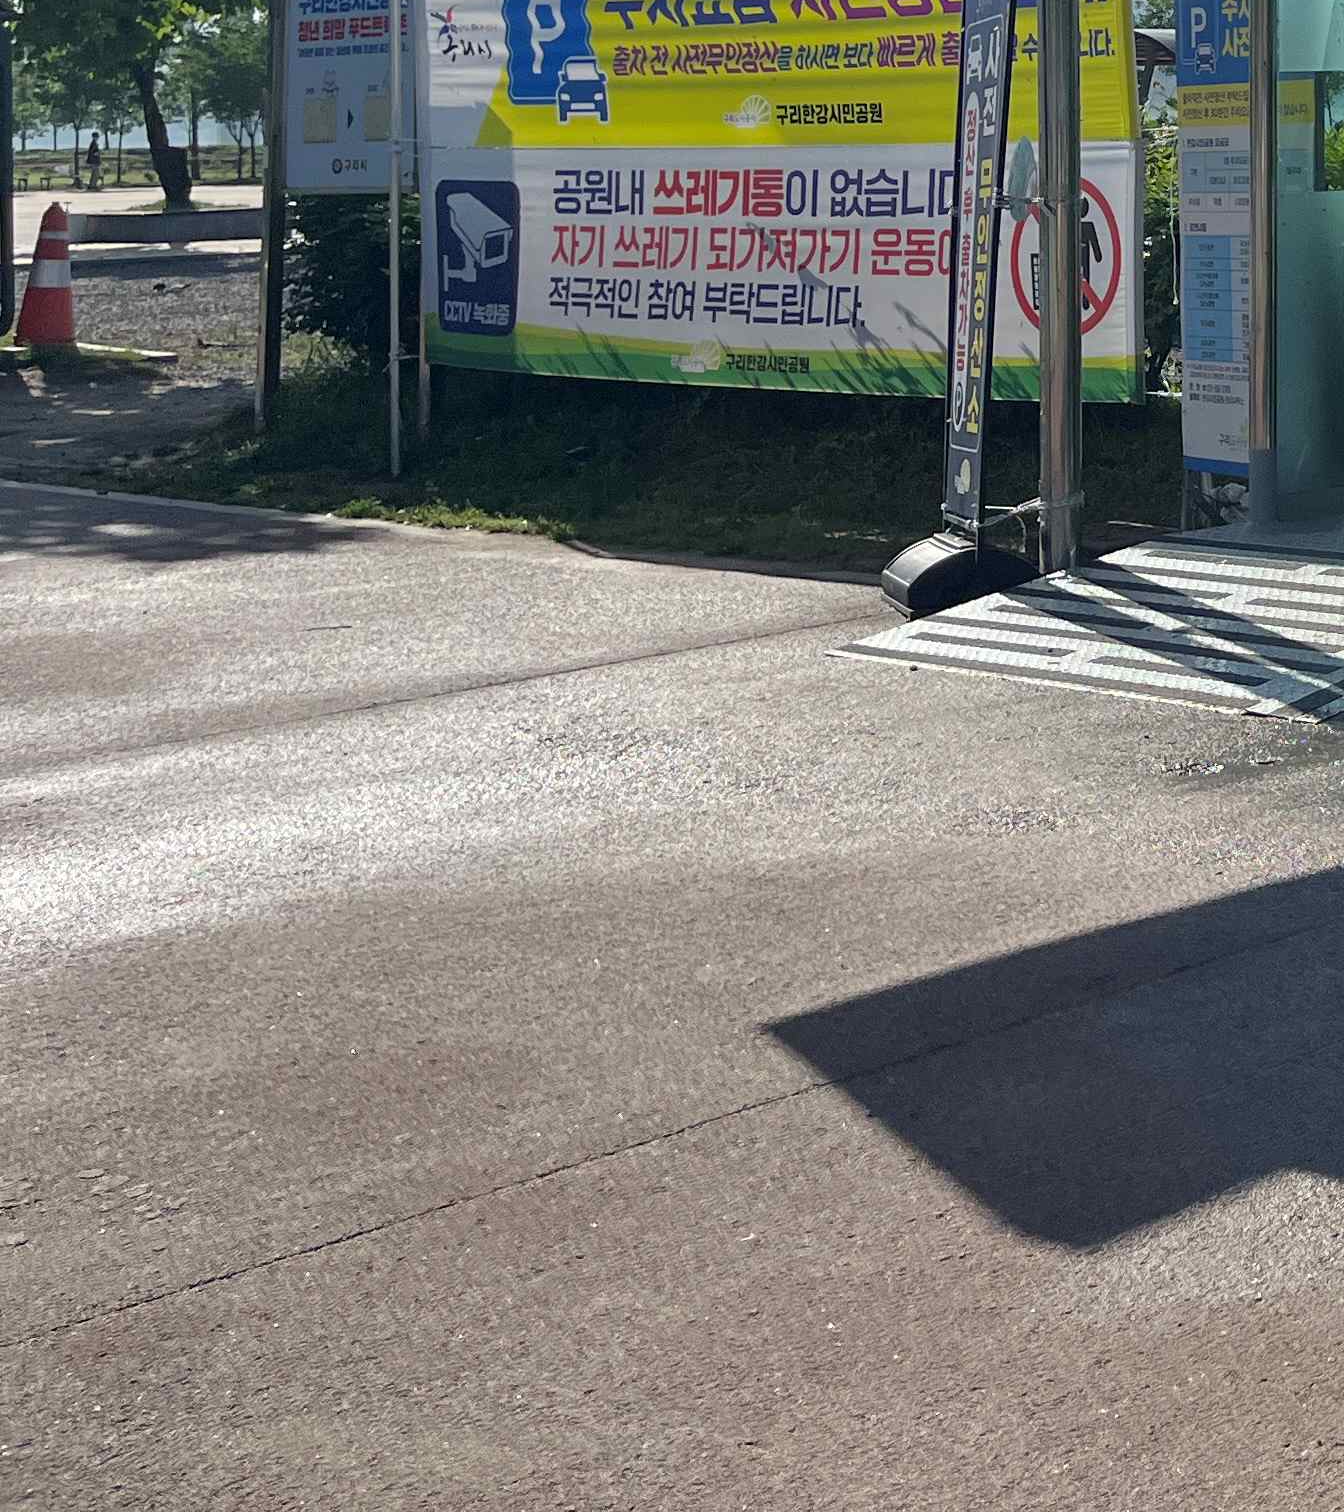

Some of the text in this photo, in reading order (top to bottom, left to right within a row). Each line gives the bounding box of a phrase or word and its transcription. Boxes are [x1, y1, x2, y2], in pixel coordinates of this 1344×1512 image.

[1190, 7, 1208, 49] P
[613, 44, 648, 76] 출차
[650, 44, 669, 76] 전
[672, 41, 793, 76] 사전무인정산을
[795, 44, 842, 70] 하시면
[843, 42, 875, 70] 보다
[877, 32, 936, 68] 빠르게
[776, 102, 884, 125] 구리한강시민공원
[552, 168, 645, 217] 공원내
[652, 168, 820, 218] 쓰레기통이
[551, 224, 606, 270] 자기
[613, 225, 700, 272] 쓰레기
[706, 227, 861, 275] 되가져가기
[443, 300, 512, 326] CCTV 녹화중
[548, 276, 867, 328] 적극적인 참여 부탁드립니다.
